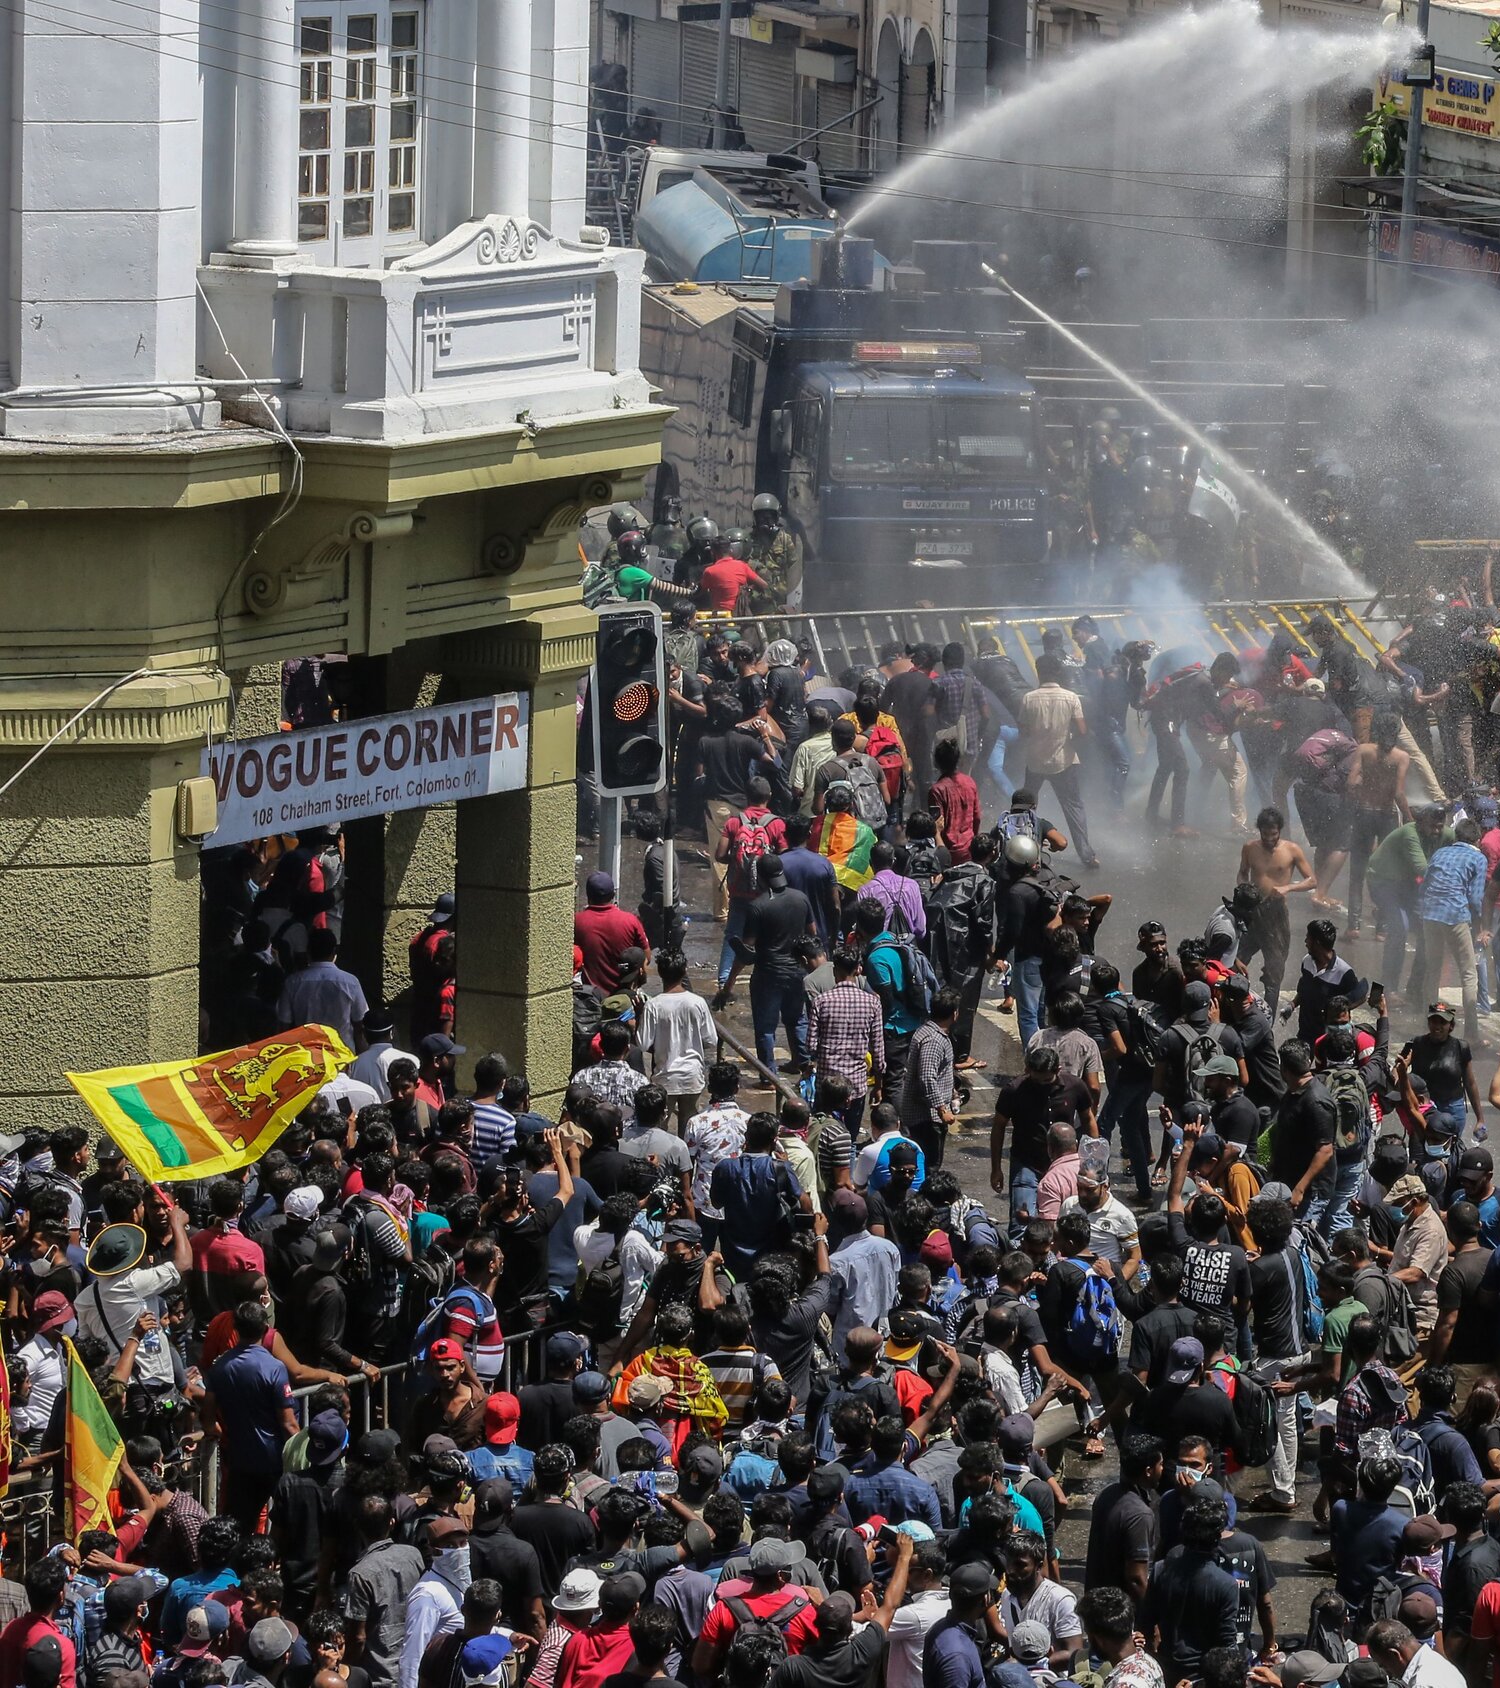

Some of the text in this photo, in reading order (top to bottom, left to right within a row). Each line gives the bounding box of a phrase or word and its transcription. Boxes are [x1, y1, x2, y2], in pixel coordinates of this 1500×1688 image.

[1448, 77, 1479, 99] GEMS
[916, 501, 943, 509] VIJAY
[990, 498, 1036, 511] POLICE
[208, 704, 519, 803] VOGUE CORNER
[252, 807, 274, 828] 108
[280, 799, 332, 822] Chatham
[407, 776, 460, 797] Colombo
[1185, 1246, 1232, 1269] RAISE
[1184, 1263, 1229, 1284] A SLICE
[1190, 1280, 1205, 1291] THE
[1205, 1283, 1226, 1293] NEXT
[1191, 1289, 1223, 1305] YEARS
